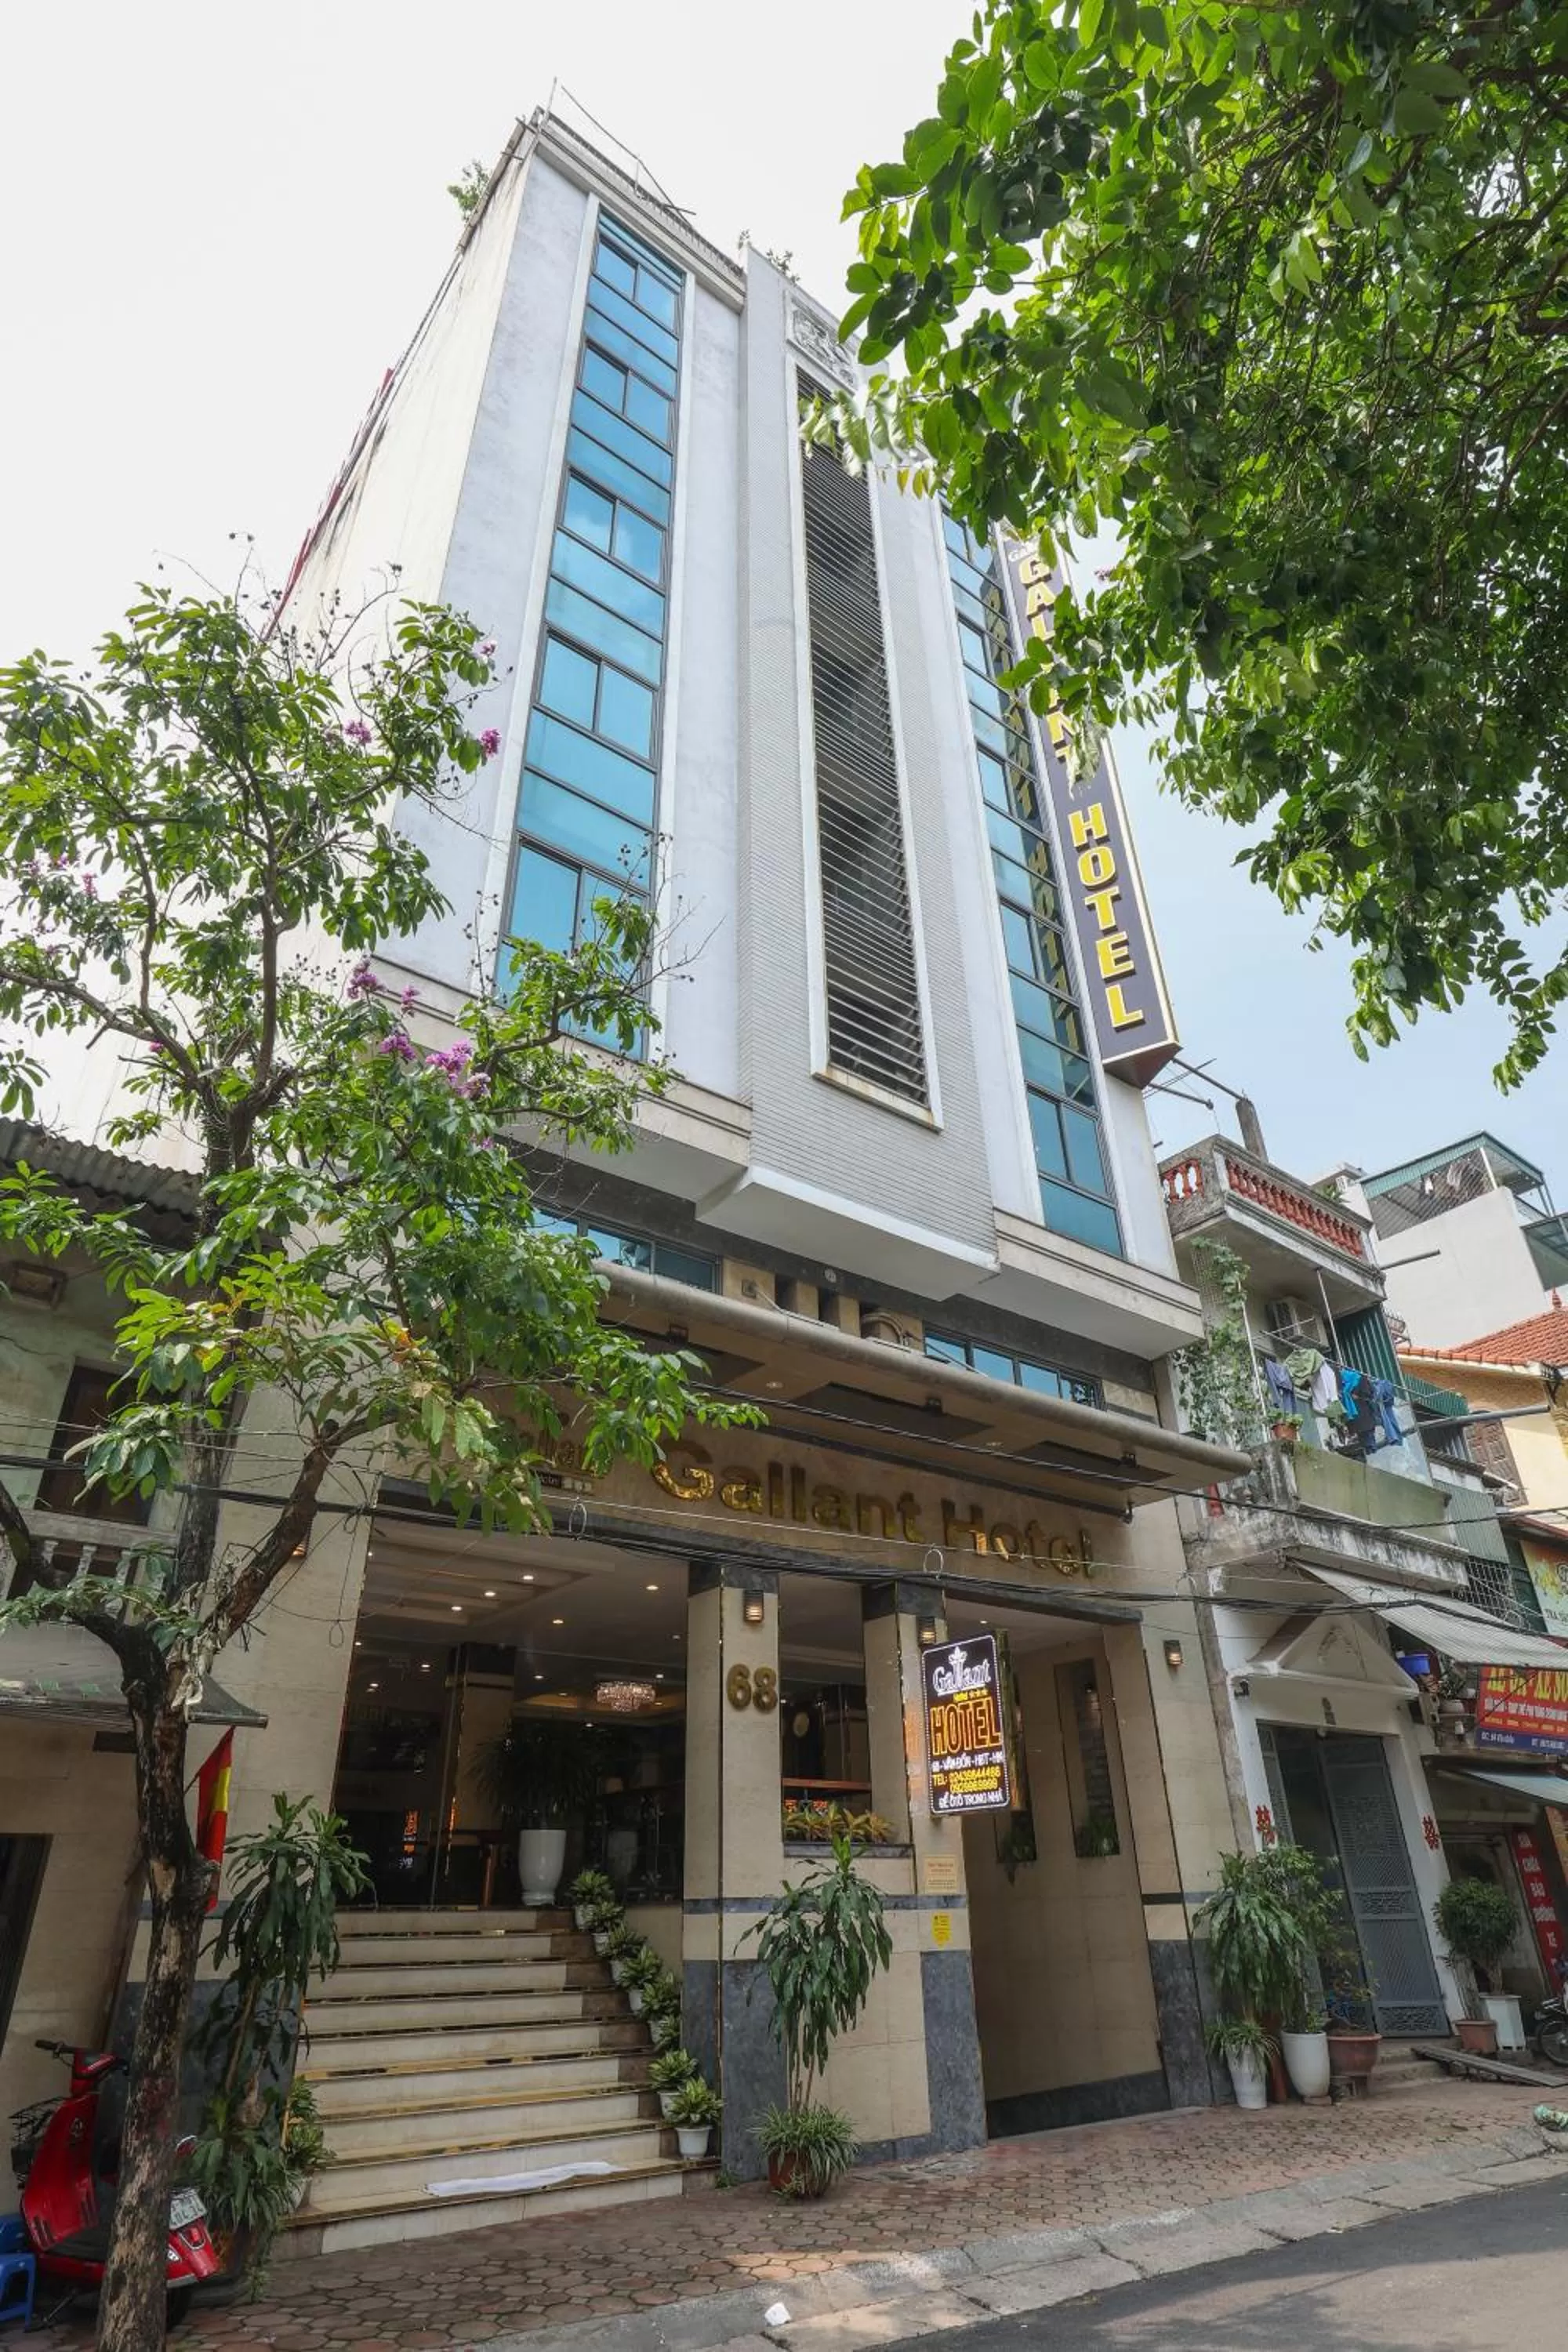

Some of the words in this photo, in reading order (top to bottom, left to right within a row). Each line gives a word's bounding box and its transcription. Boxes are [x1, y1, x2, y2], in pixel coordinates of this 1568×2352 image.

[1068, 802, 1145, 1030] HOTEL
[652, 1439, 926, 1545] Gallant
[942, 1498, 1094, 1578] Hotel
[726, 1663, 778, 1715] 68
[933, 1657, 991, 1693] Gallant
[931, 1698, 1003, 1755] HOTEL
